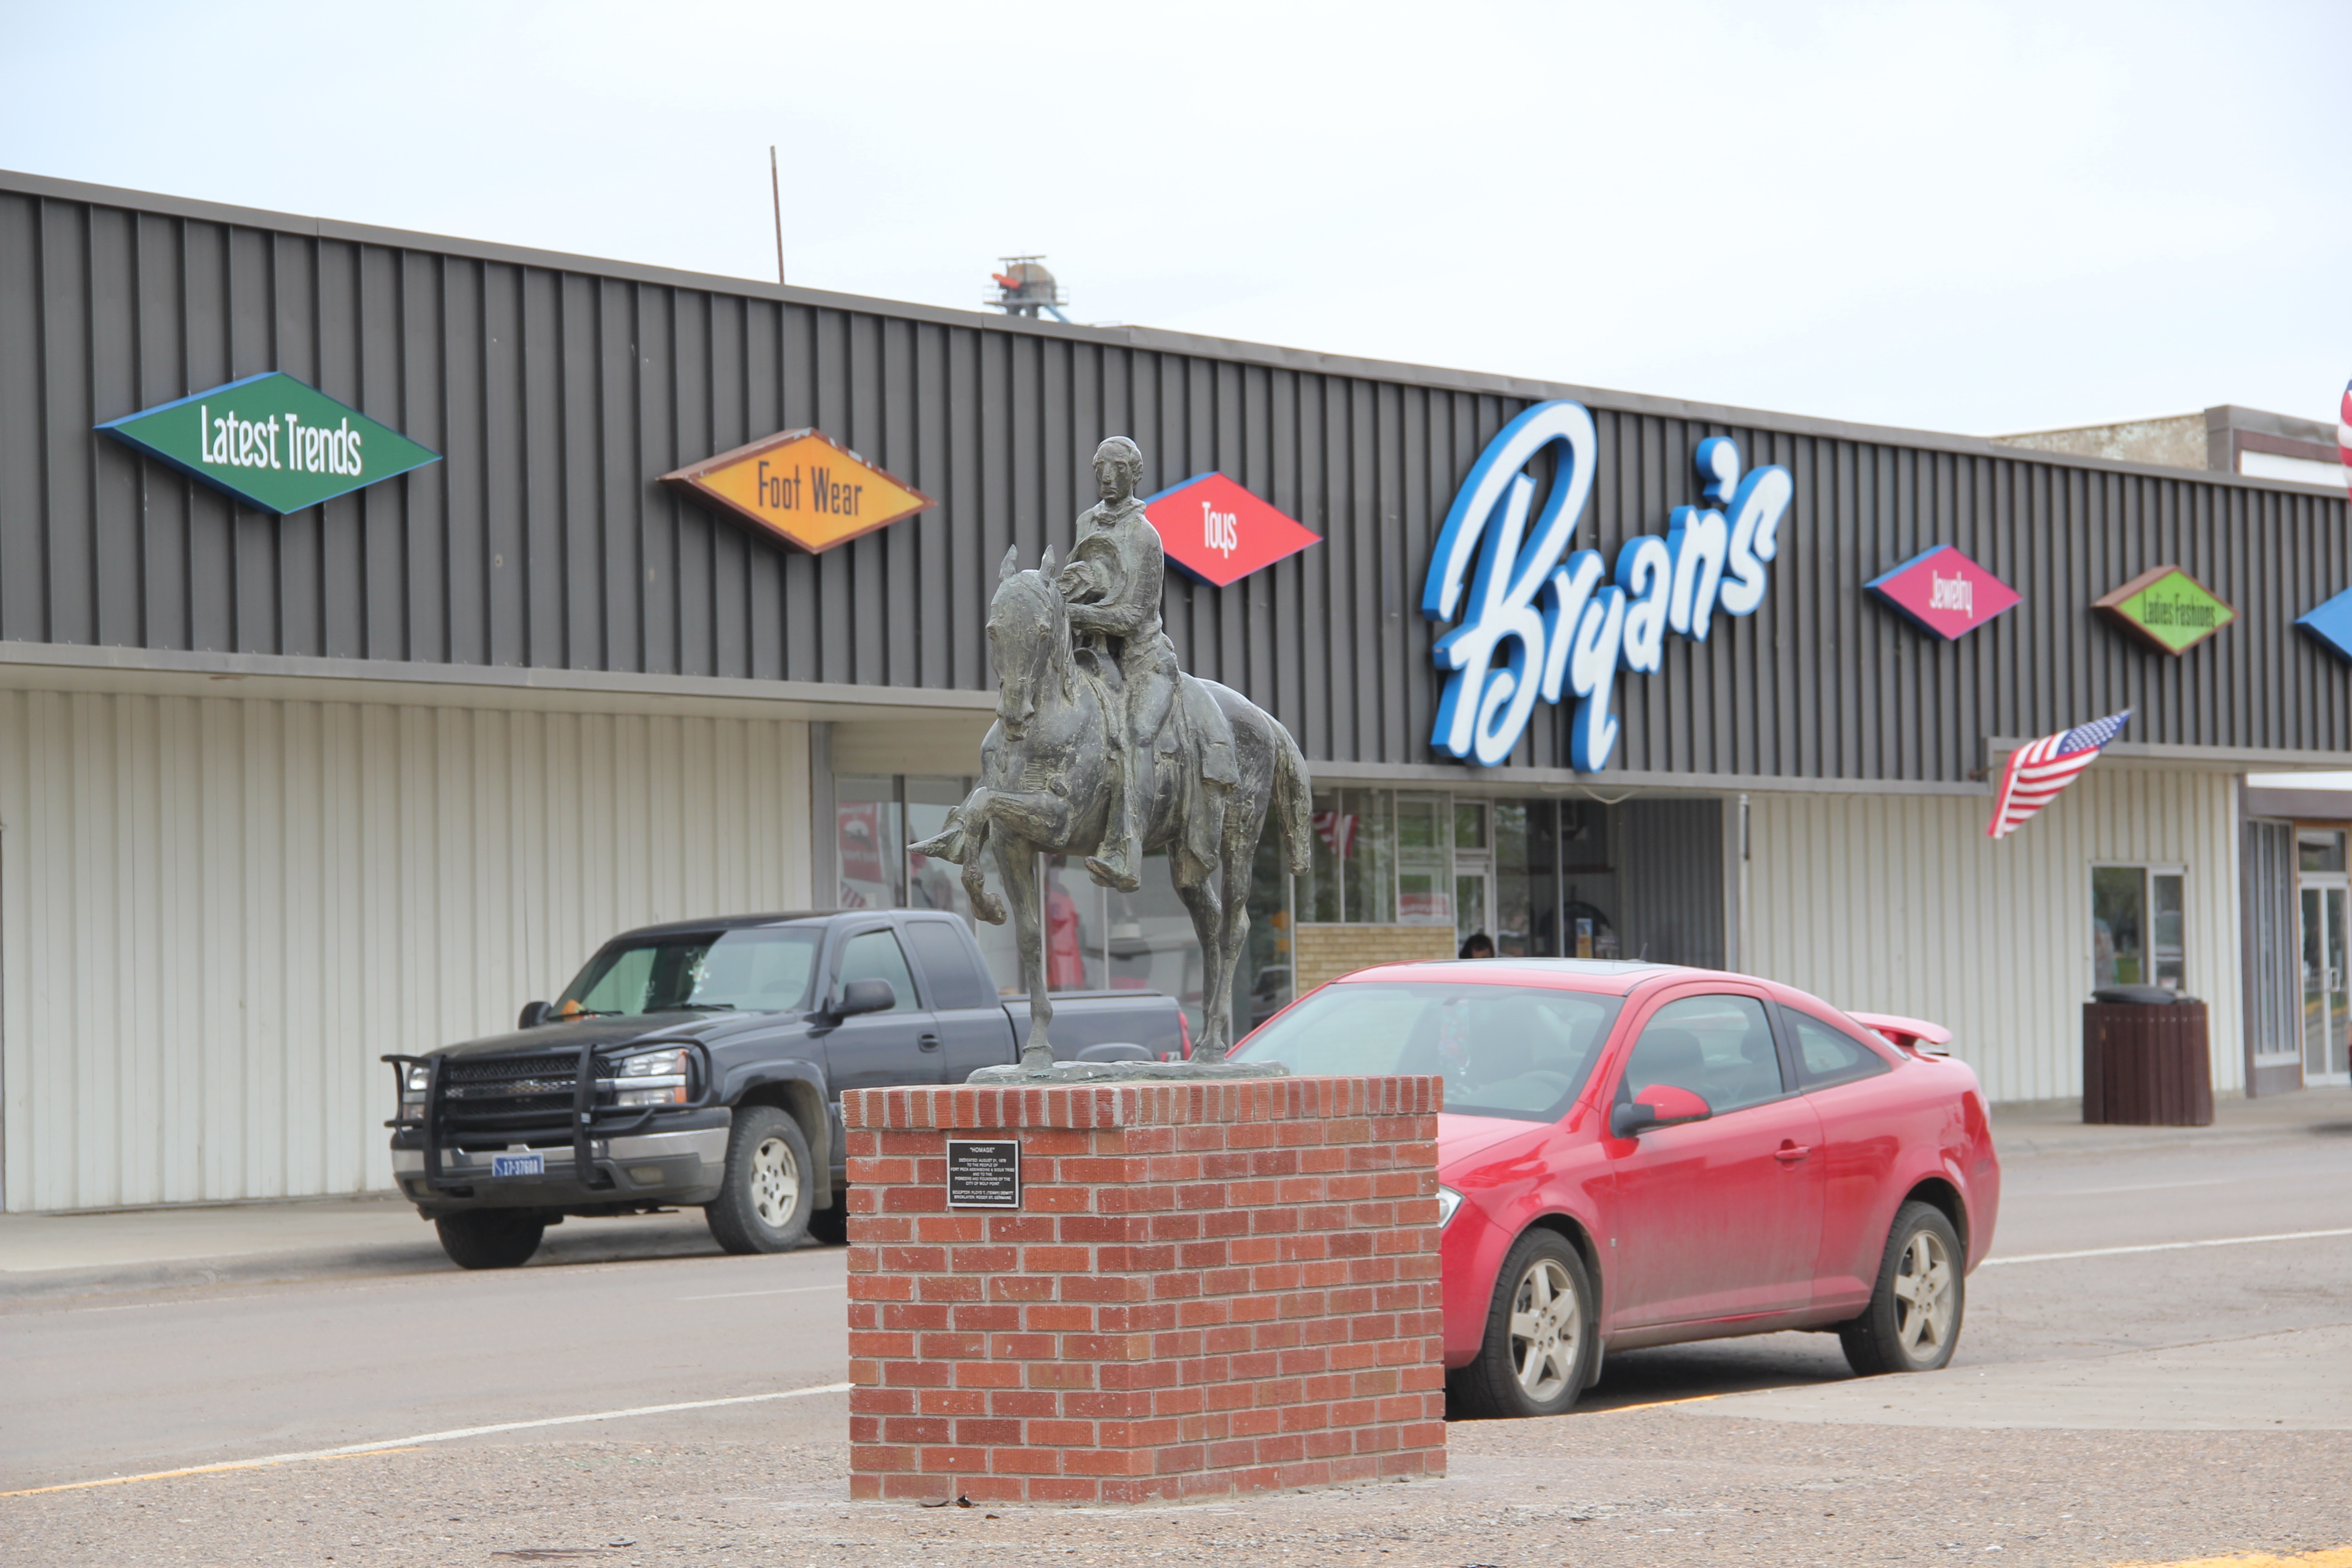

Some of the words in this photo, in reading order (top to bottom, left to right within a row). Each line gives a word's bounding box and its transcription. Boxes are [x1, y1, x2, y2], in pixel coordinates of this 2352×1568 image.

[201, 405, 281, 469] Latest
[284, 412, 362, 475] Trends
[759, 460, 801, 511] Foot
[811, 466, 862, 516] Wear
[1202, 501, 1238, 559] Toys
[1423, 399, 1793, 773] Bryan's
[1930, 569, 1973, 619] Jewelry
[2143, 590, 2173, 624] Ladies
[2175, 592, 2215, 628] Fashions
